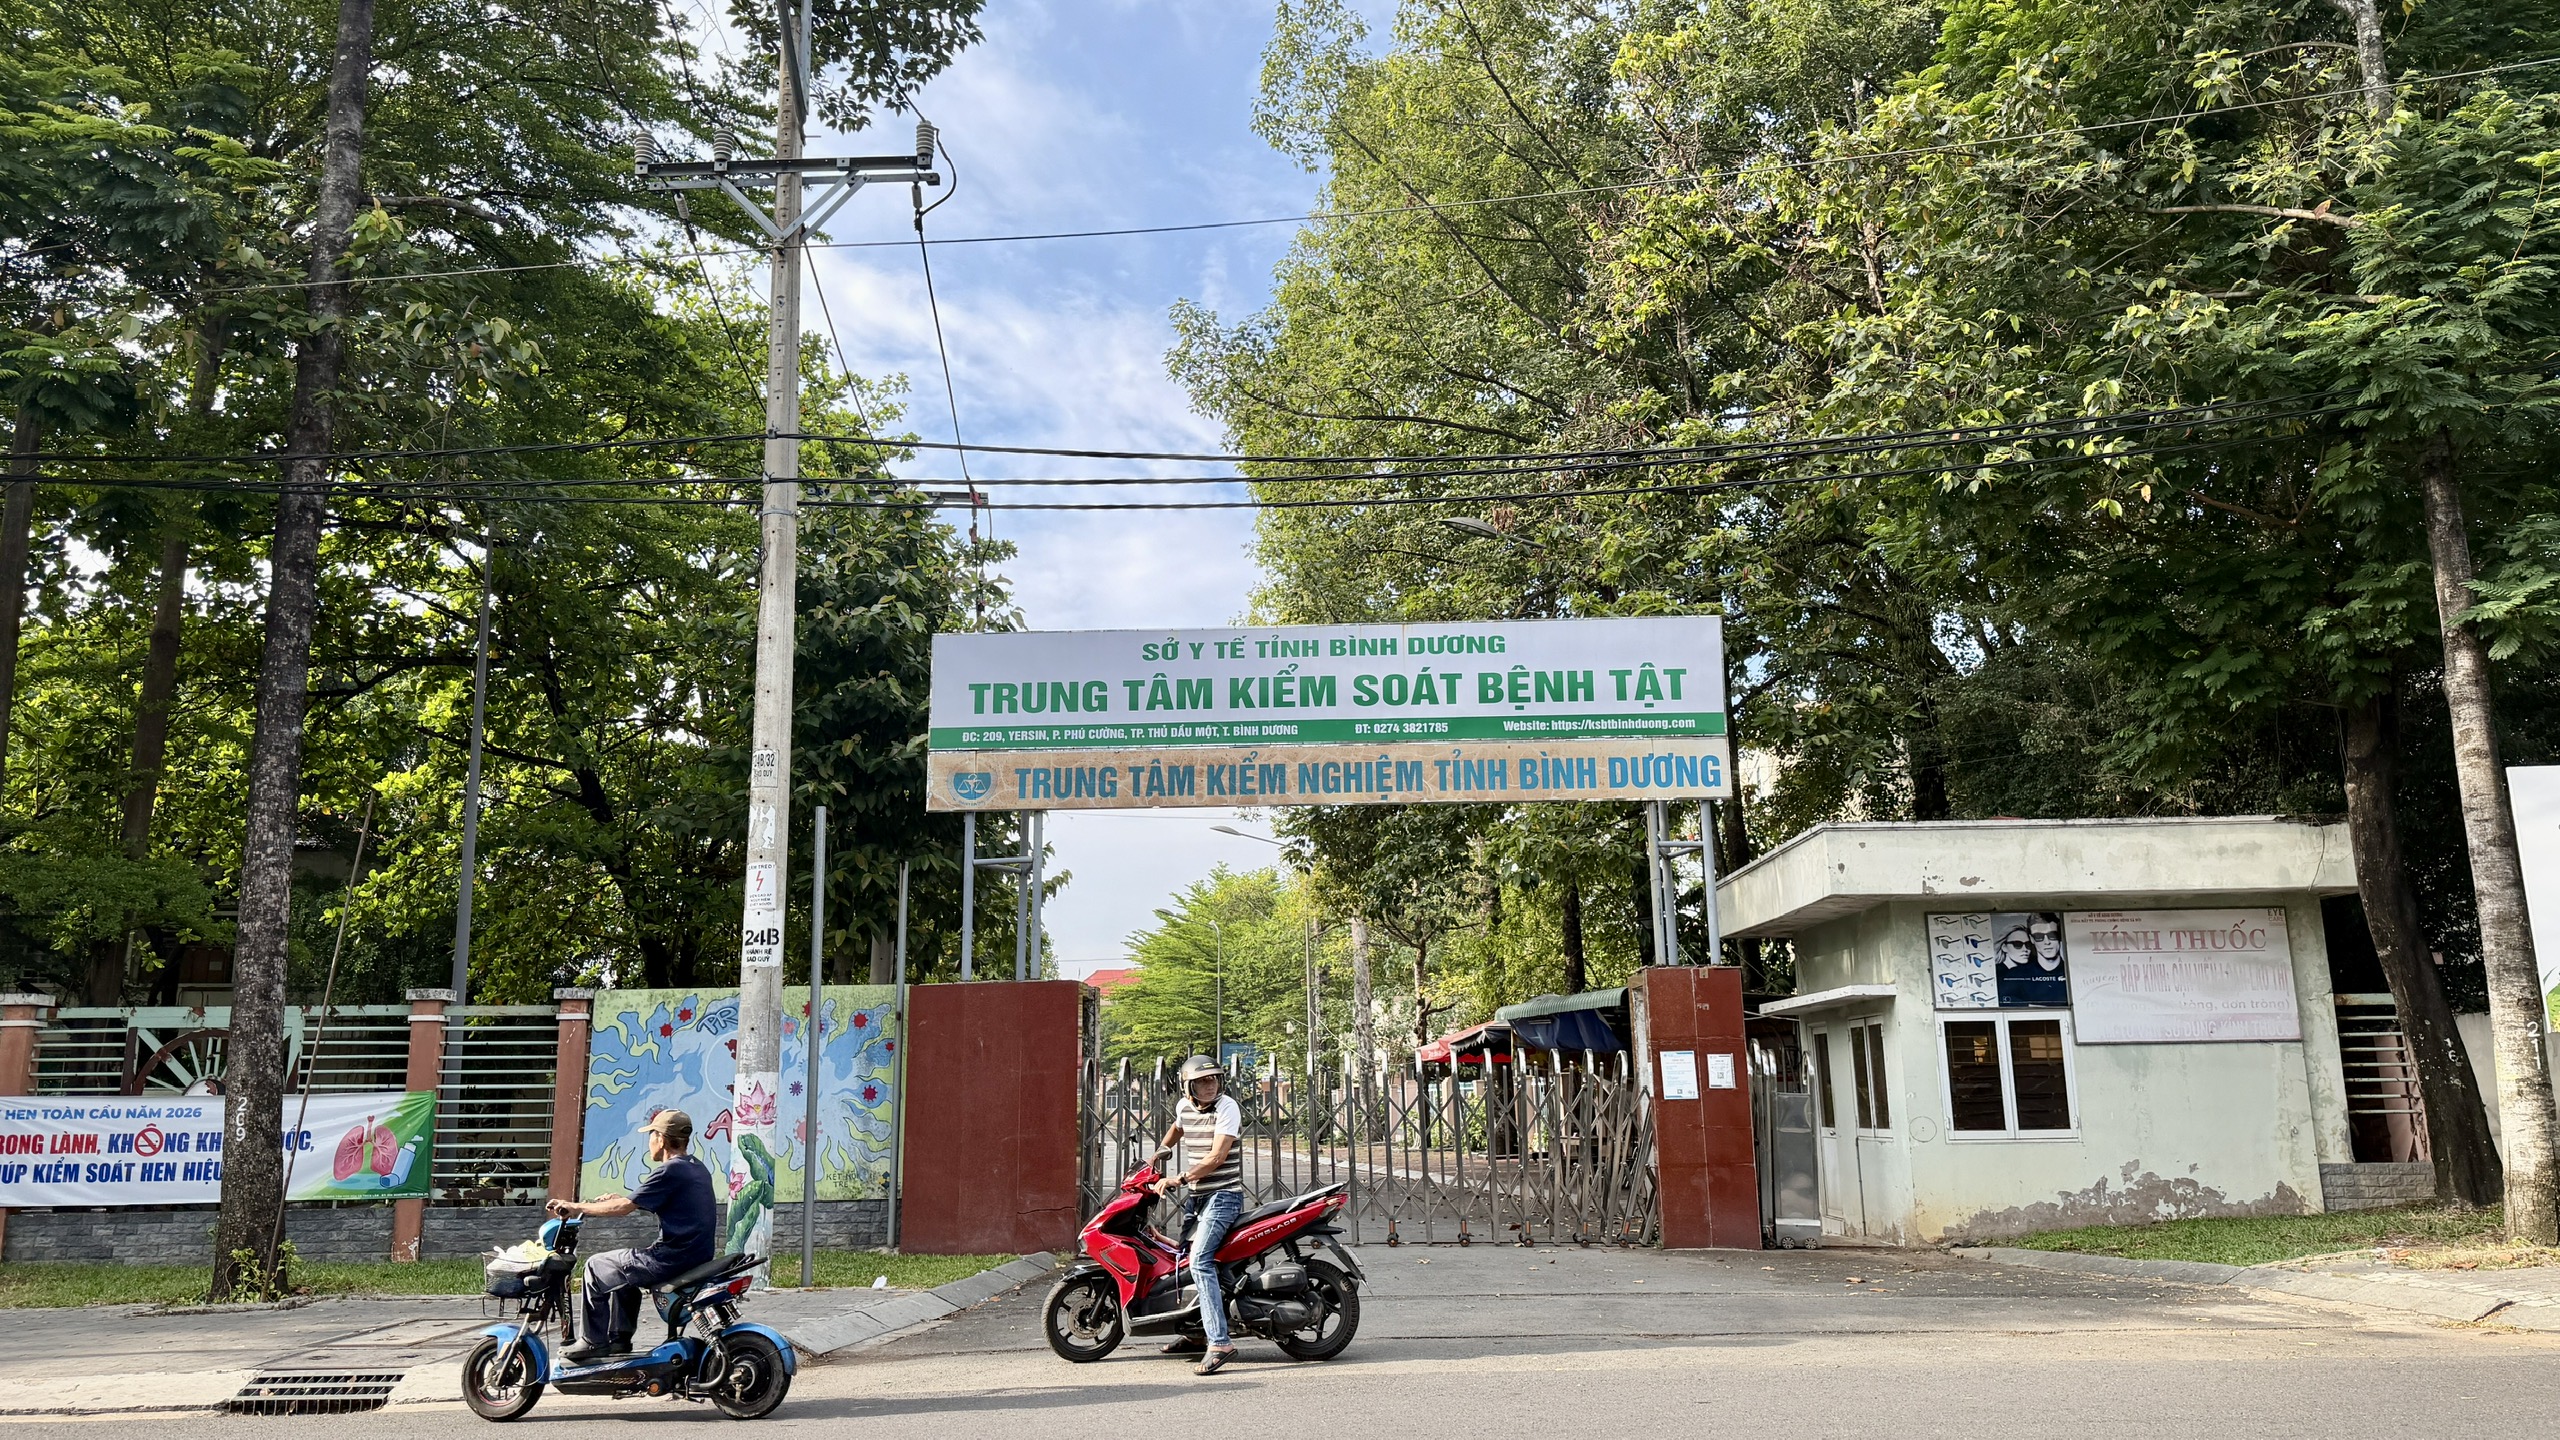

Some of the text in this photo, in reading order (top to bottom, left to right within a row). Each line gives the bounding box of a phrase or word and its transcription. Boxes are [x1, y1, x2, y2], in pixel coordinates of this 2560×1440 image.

[1142, 634, 1506, 661] SỞ Y TẾ TỈNH BÌNH DƯƠNG
[969, 662, 1688, 715] TRUNG TÂM KIỂM SOÁT BỆNH TẬT
[962, 723, 1299, 743] ĐC: 209, YERSIN, P. PHÚ CƯỜNG, TP. THỦ DẦU MỘT, T. BÌNH DƯƠNG
[1354, 722, 1449, 734] ĐT: 0274 3821785
[1503, 718, 1696, 732] Website: https://ksbtbinhduong.com
[1014, 748, 1722, 800] TRUNG TÂM KIỂM NGHIỆM TỈNH BÌNH DƯƠNG
[744, 928, 780, 946] 24B
[2090, 919, 2267, 951] KÍNH THUỐC
[696, 1006, 738, 1035] PR
[5, 1105, 202, 1120] HEN TOÀN CẦU NĂM 2026
[49, 1131, 102, 1156] LÀNH,
[195, 1131, 223, 1153] KH
[0, 1157, 223, 1185] ÚP KIỂM SOÁT HEN HIỆU
